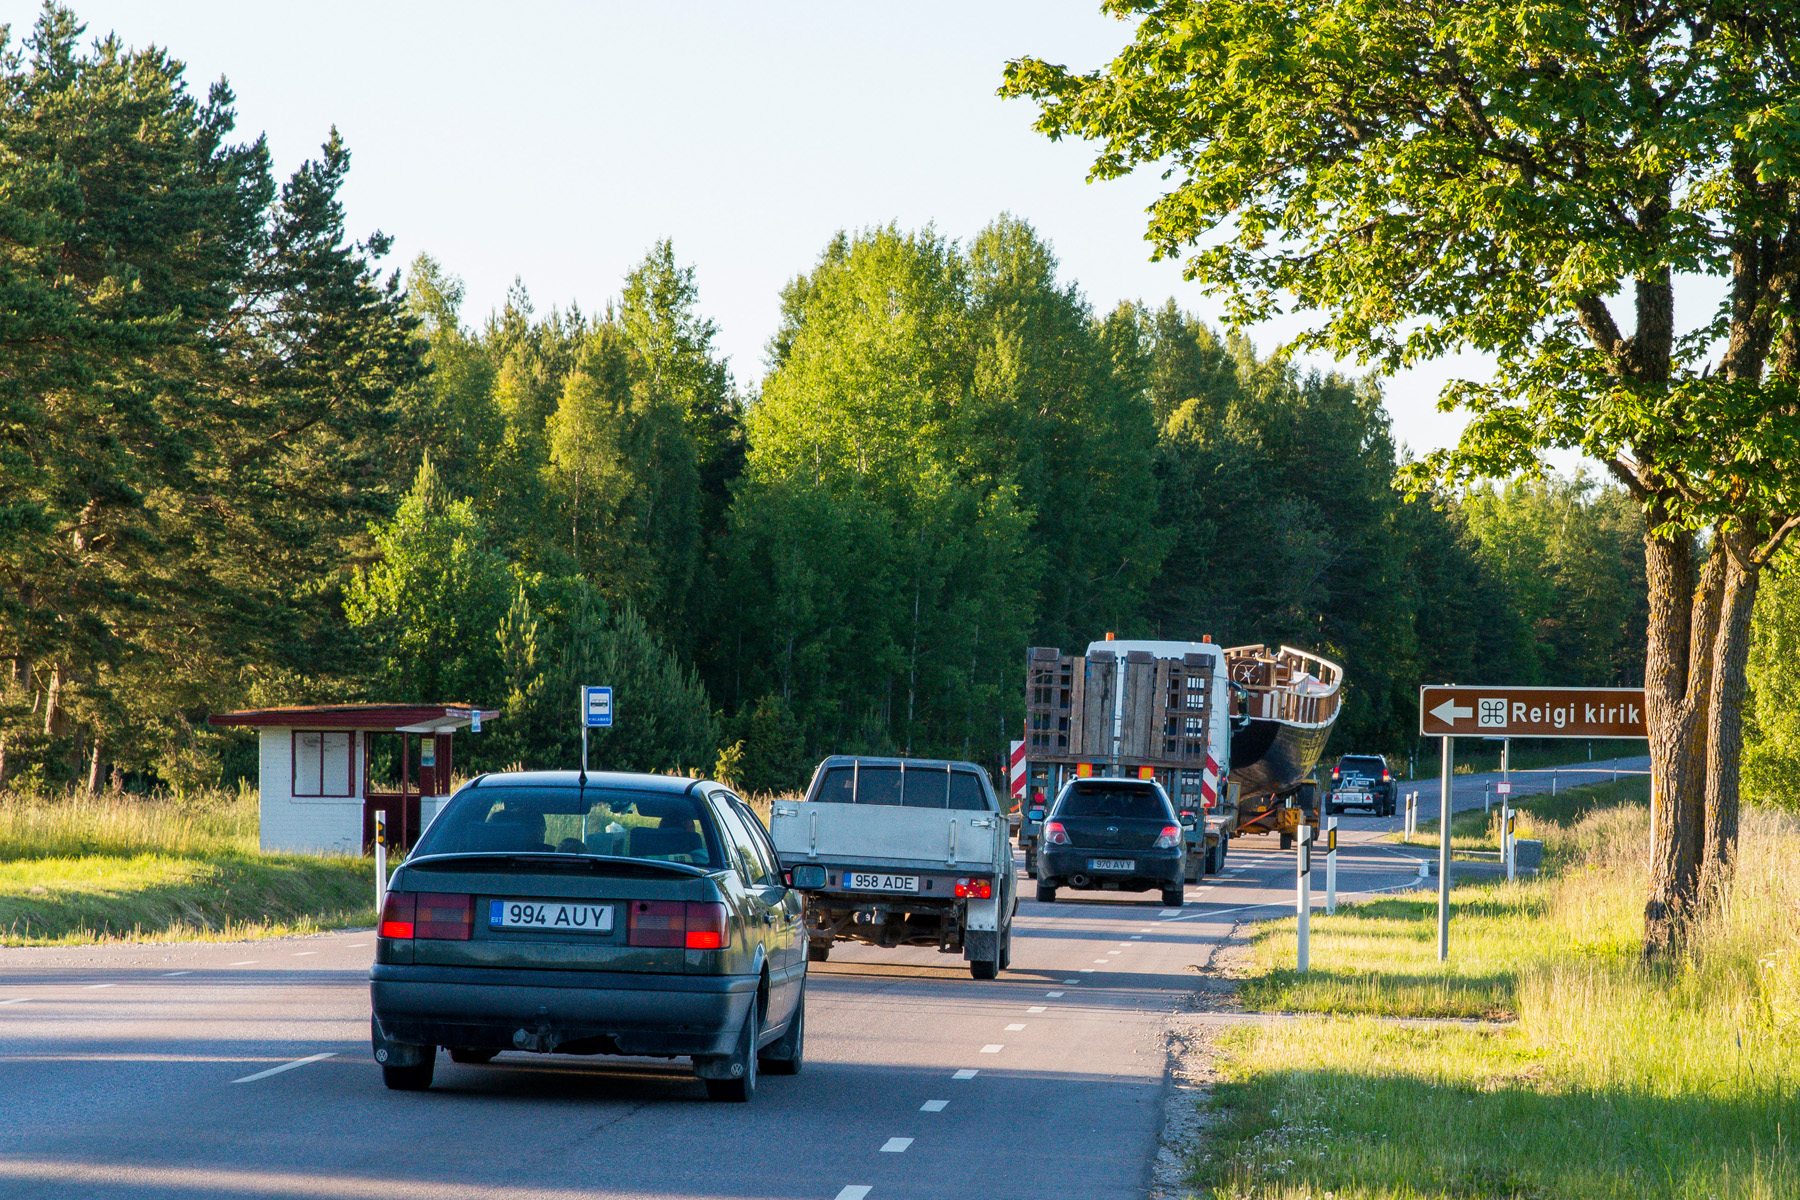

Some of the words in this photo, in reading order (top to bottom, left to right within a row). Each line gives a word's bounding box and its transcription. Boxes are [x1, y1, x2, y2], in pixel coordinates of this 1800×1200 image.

[1512, 702, 1575, 729] Reigi
[1585, 703, 1640, 724] kirik
[1096, 860, 1111, 869] 970
[1113, 861, 1131, 869] AVY
[855, 874, 879, 888] 958
[883, 876, 914, 890] ADE
[510, 904, 546, 925] 994
[554, 906, 605, 927] AUY
